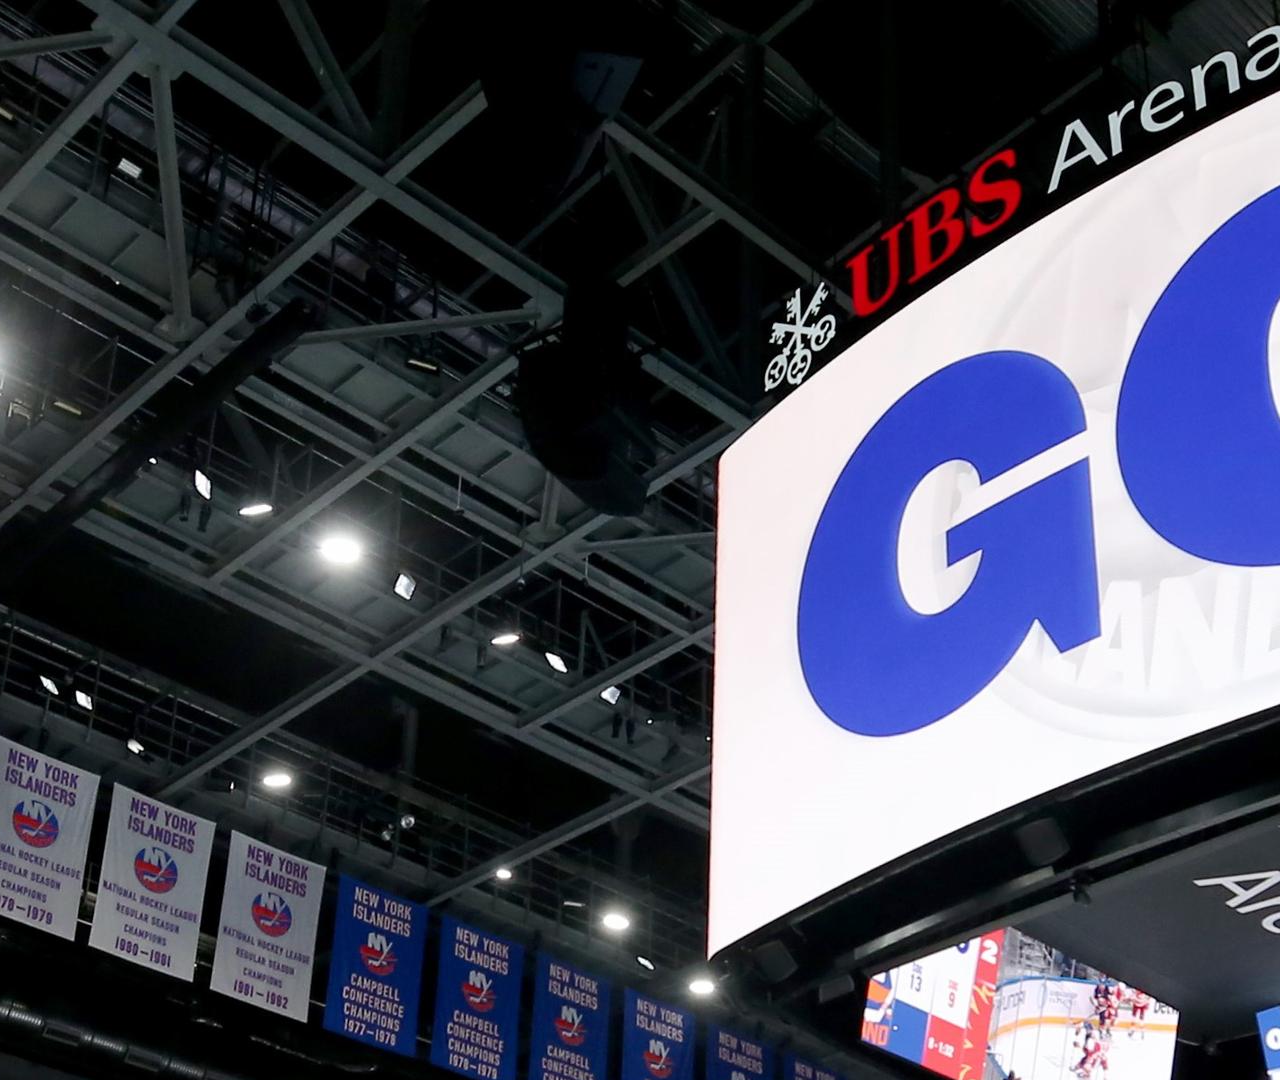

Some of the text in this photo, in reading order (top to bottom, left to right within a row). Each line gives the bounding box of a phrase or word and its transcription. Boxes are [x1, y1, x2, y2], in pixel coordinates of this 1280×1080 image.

[845, 149, 1021, 318] UBS
[7, 748, 79, 790] NEW YORK
[4, 766, 76, 807] ISLANDERS
[130, 797, 197, 836] NEW YORK
[128, 815, 195, 854] ISLANDERS
[18, 848, 49, 868] HOCKEY
[50, 861, 82, 880] LEAGUE
[247, 844, 309, 881] NEW YORK
[0, 879, 48, 903] CHAMPIONS
[30, 871, 61, 891] SEASON
[245, 861, 307, 897] ISLANDERS
[102, 880, 198, 924] NATIONAL HOCKEY LEAGUE
[354, 886, 412, 920] NEW YORK
[116, 903, 180, 934] REGULAR SEASON
[353, 903, 411, 938] ISLANDERS
[124, 923, 167, 947] CHAMPIONS
[456, 926, 510, 959] NEW YORK
[455, 943, 509, 976] ISLANDERS
[980, 939, 998, 964] 2
[350, 973, 400, 1002] CAMPBELL
[549, 979, 598, 1010] ISLANDERS
[550, 963, 598, 994] NEW YORK
[342, 986, 405, 1018] CONFERENCE
[344, 1002, 400, 1032] CHAMPIONS
[447, 1022, 504, 1052] CONFERENCE
[453, 1009, 499, 1037] CAMPBELL
[448, 1038, 500, 1066] CHAMPIONS
[547, 1045, 590, 1070] CAMPBELL
